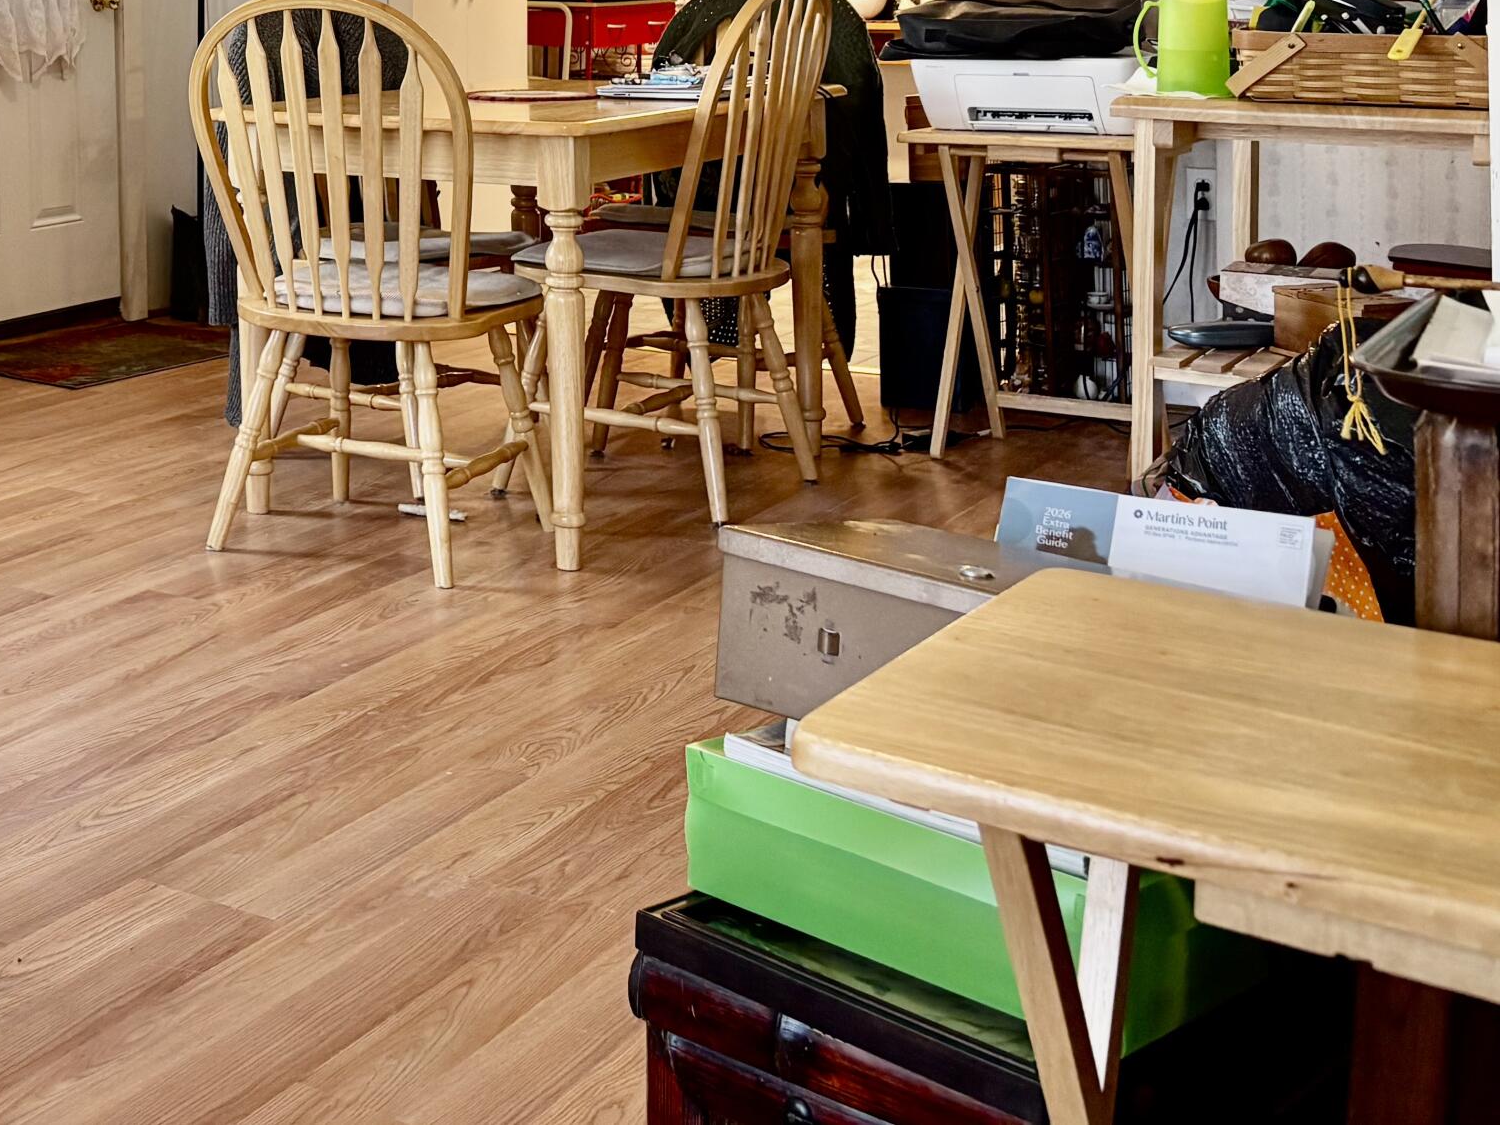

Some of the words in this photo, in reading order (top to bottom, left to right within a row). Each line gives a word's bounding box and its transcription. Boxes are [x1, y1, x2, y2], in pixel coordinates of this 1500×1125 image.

[1044, 506, 1072, 519] 2026
[1042, 516, 1070, 529] Extra
[1145, 510, 1195, 527] Martin's
[1197, 516, 1228, 531] Point
[1035, 524, 1074, 540] Benefit
[1036, 535, 1069, 549] Guide
